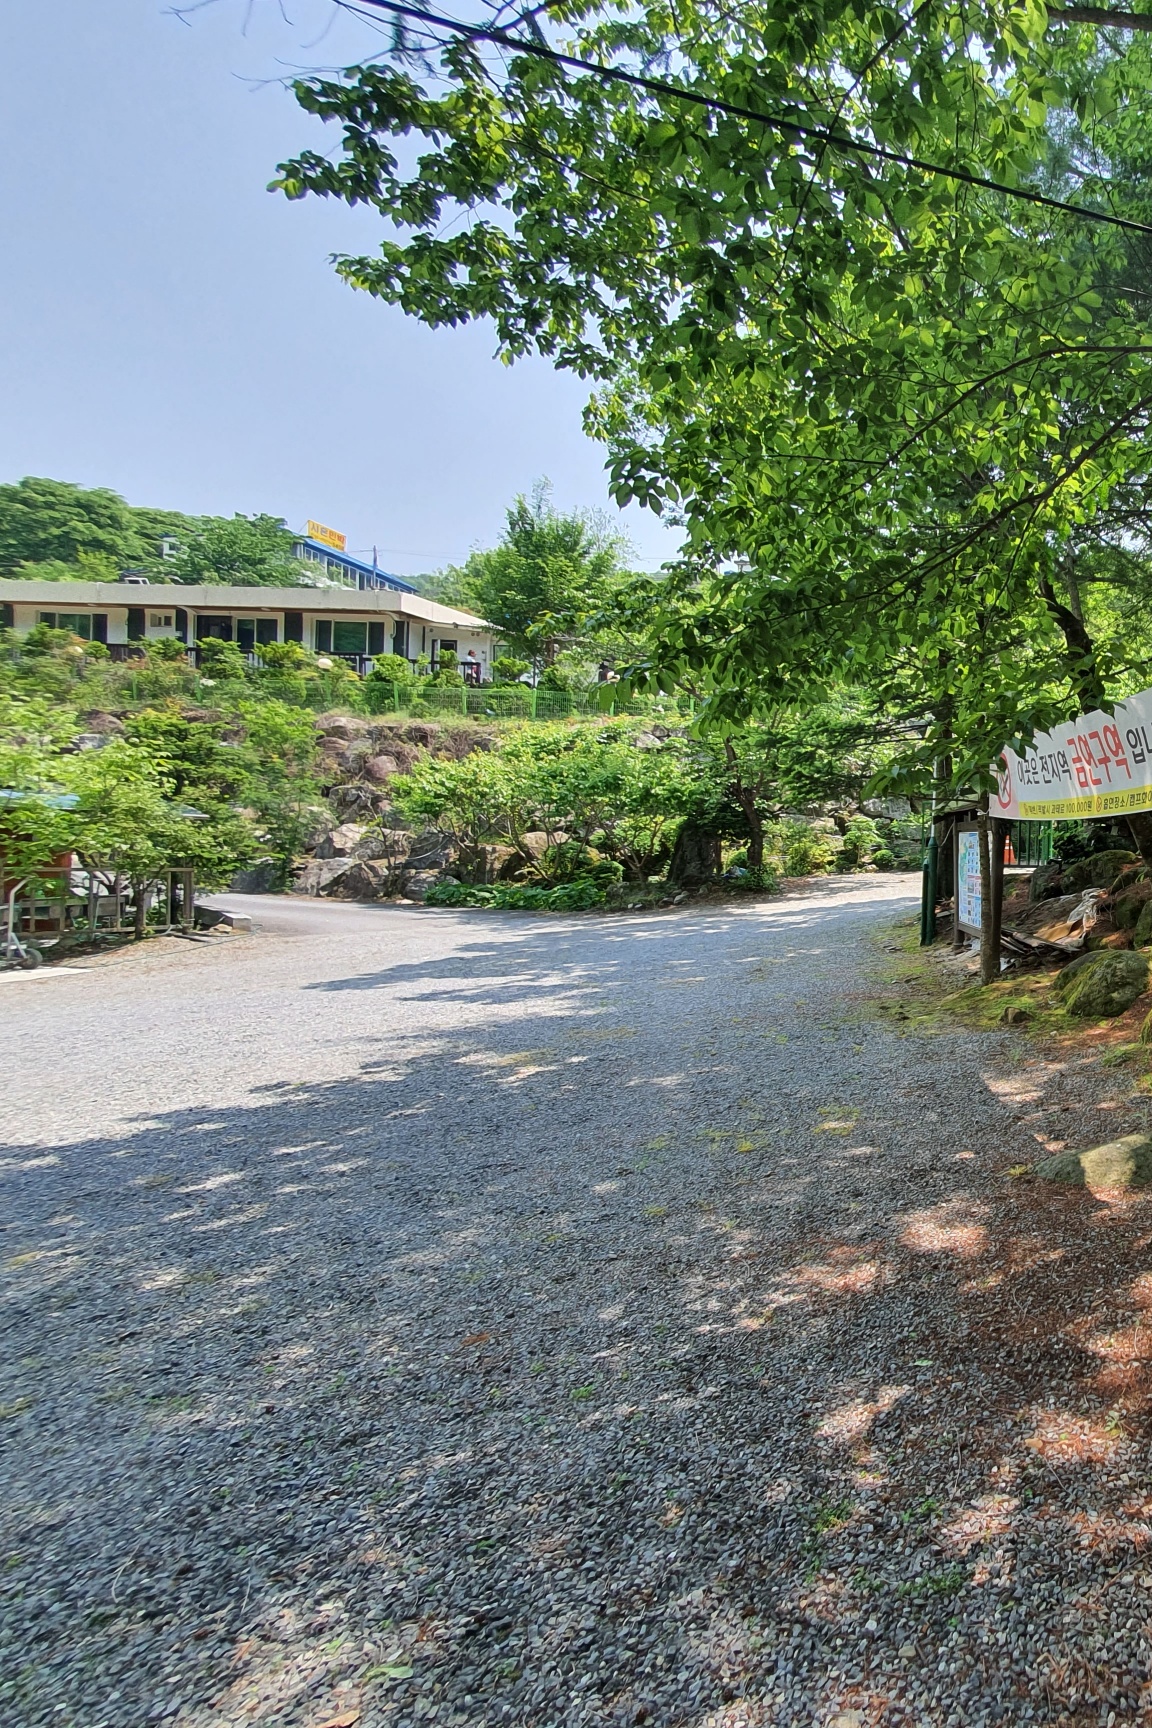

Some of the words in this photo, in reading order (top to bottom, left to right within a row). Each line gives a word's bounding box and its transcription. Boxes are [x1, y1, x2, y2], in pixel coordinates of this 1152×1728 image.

[1017, 757, 1040, 786] 이곳은
[1038, 750, 1072, 784] 전지역
[1066, 723, 1132, 788] 금연구역
